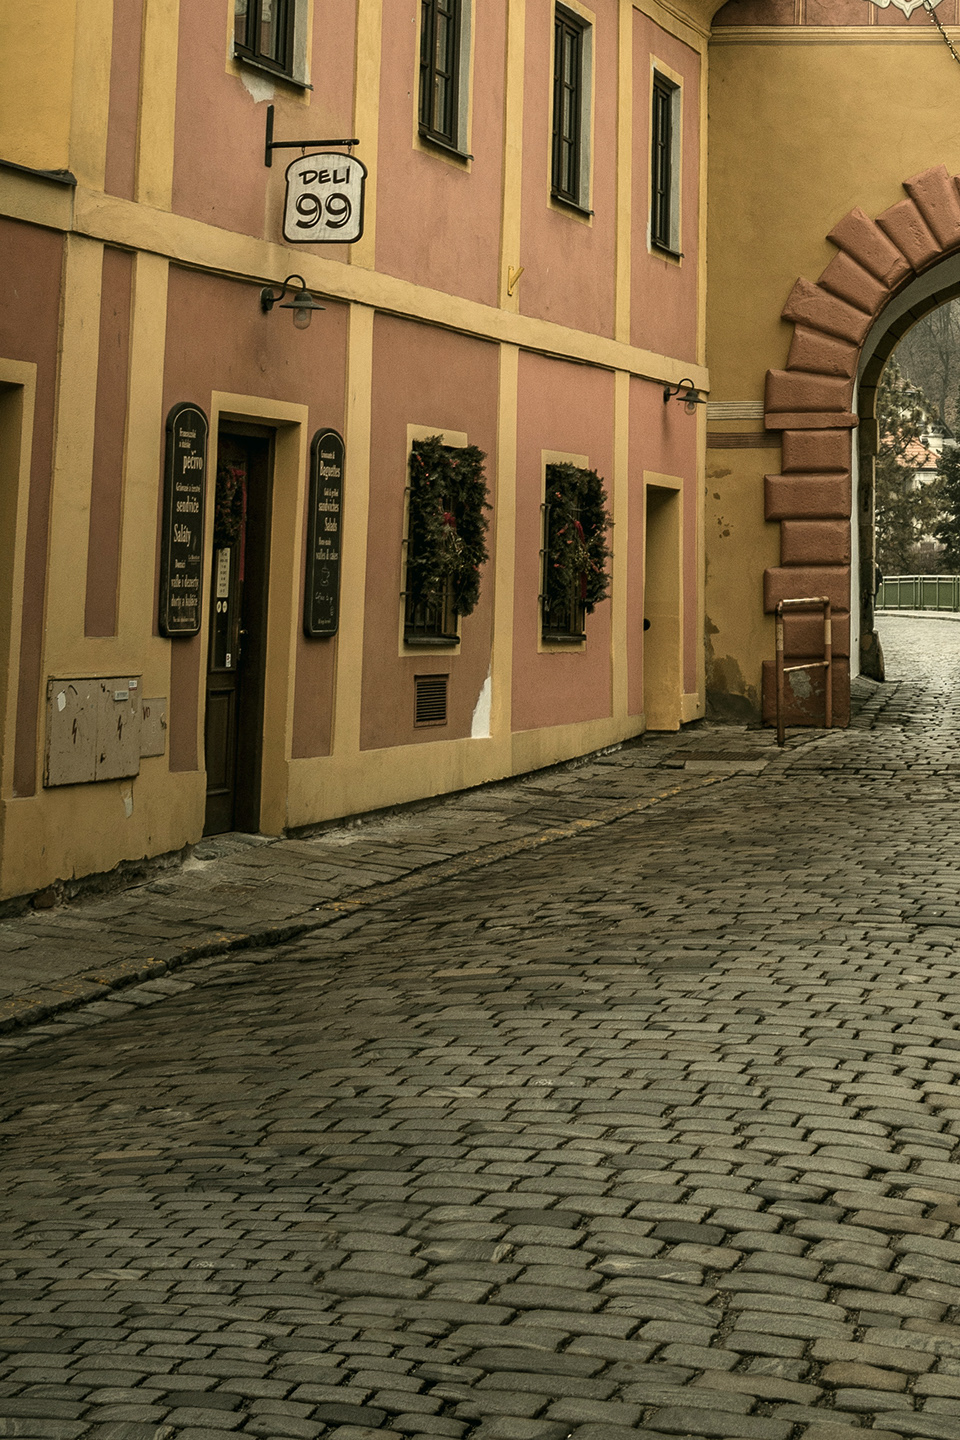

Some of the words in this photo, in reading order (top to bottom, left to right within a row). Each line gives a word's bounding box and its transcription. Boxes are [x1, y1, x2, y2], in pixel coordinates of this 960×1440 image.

[298, 166, 351, 185] DELI
[295, 193, 352, 229] 99
[182, 450, 203, 474] pečivo
[319, 460, 341, 481] Baguettes
[176, 495, 199, 513] sendviče
[173, 523, 191, 547] Saláty
[324, 517, 337, 532] Salads
